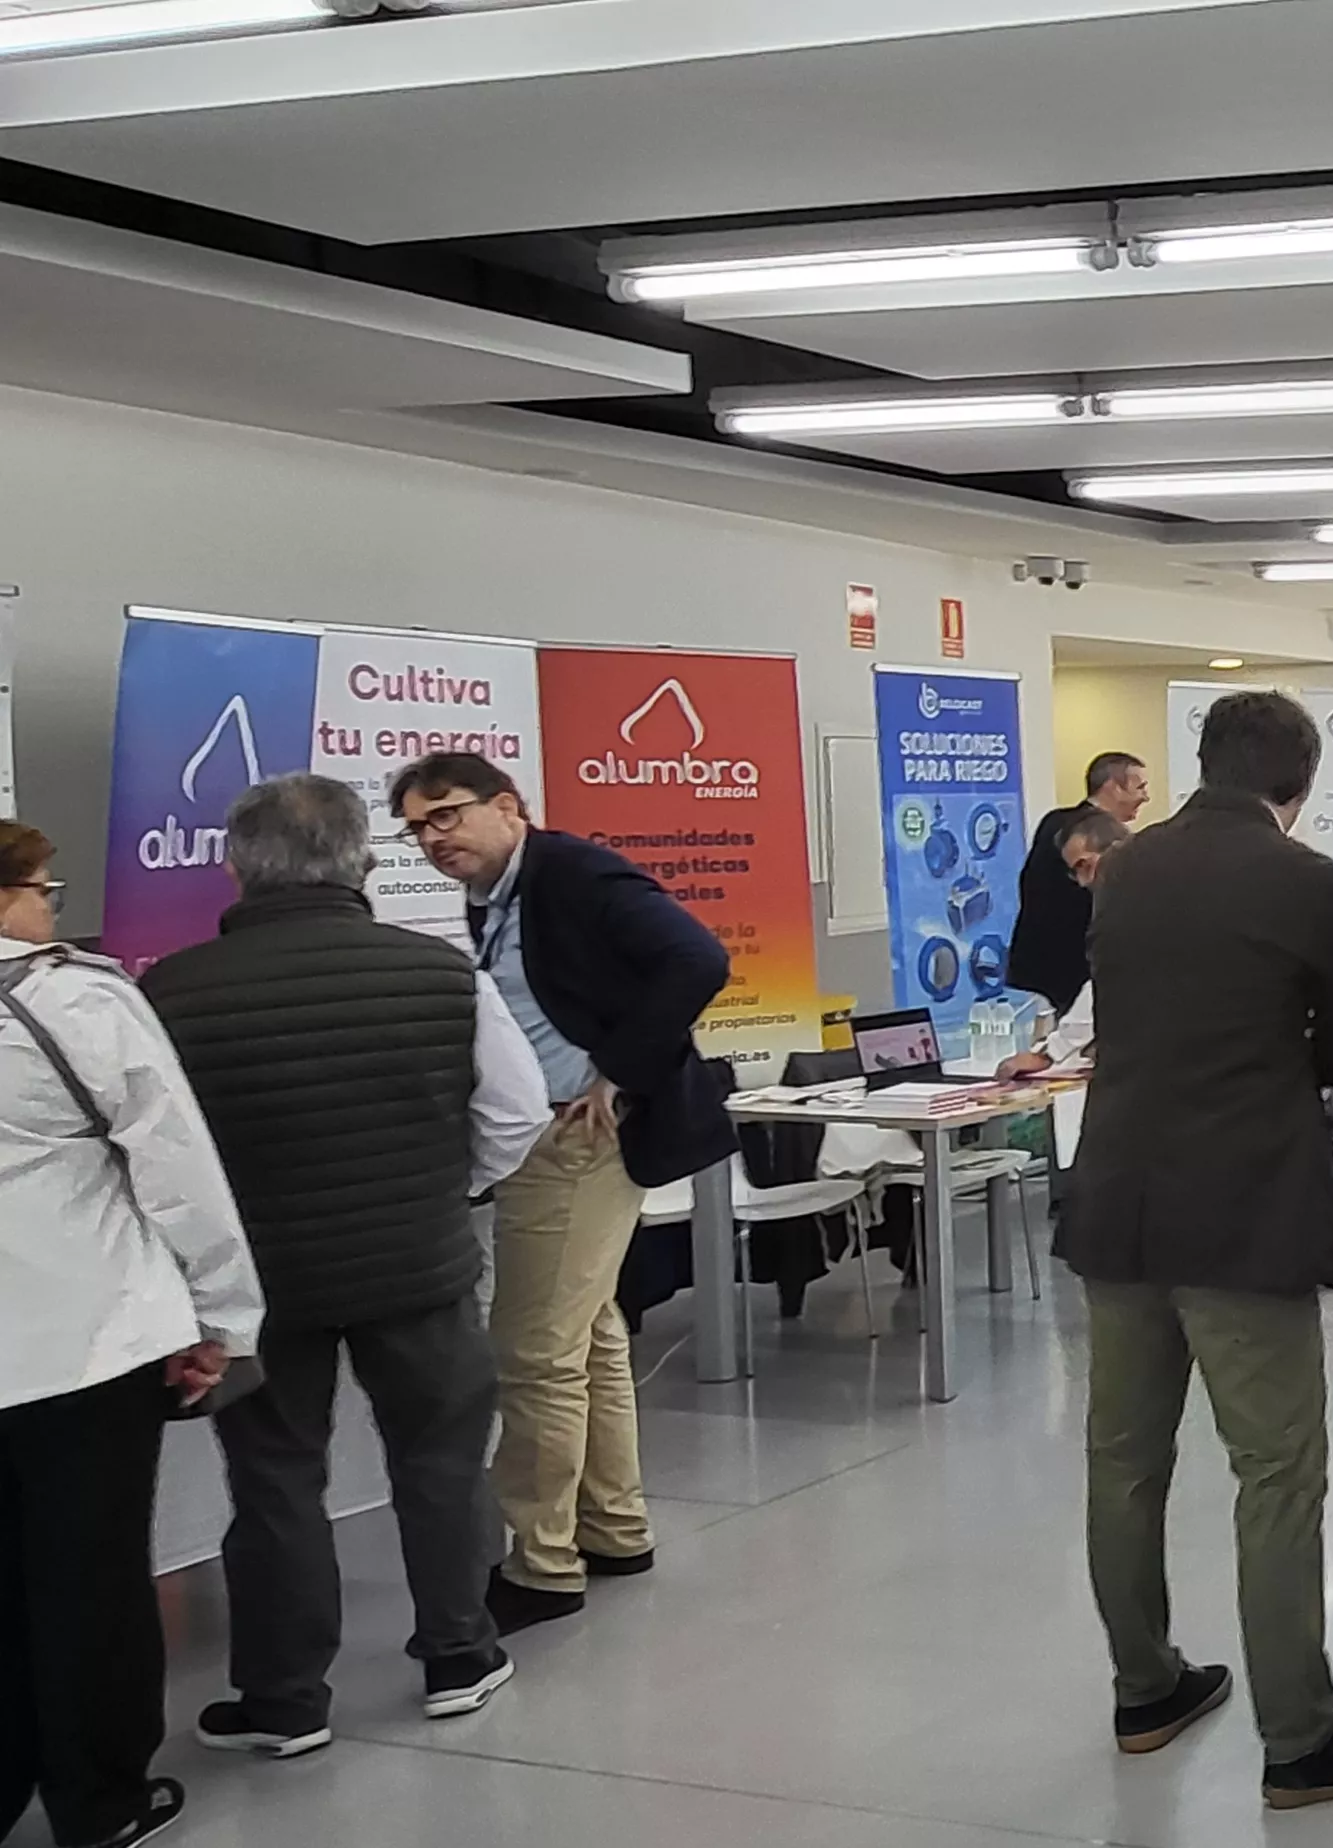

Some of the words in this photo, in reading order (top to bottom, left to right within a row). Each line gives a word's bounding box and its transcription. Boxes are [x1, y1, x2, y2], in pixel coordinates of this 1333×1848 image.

[347, 663, 493, 706] Cultiva
[318, 720, 363, 756] tu
[375, 723, 521, 759] energía
[899, 731, 1009, 757] SOLUCIONES
[578, 750, 759, 785] alumbra
[903, 759, 951, 782] PARA
[954, 759, 1008, 782] RIEGO
[695, 785, 759, 799] ENERGÍA
[138, 815, 228, 871] alum
[589, 829, 756, 848] Comunidades
[378, 880, 460, 896] autoconsu
[674, 884, 725, 901] ales
[709, 992, 760, 1008] ustrial
